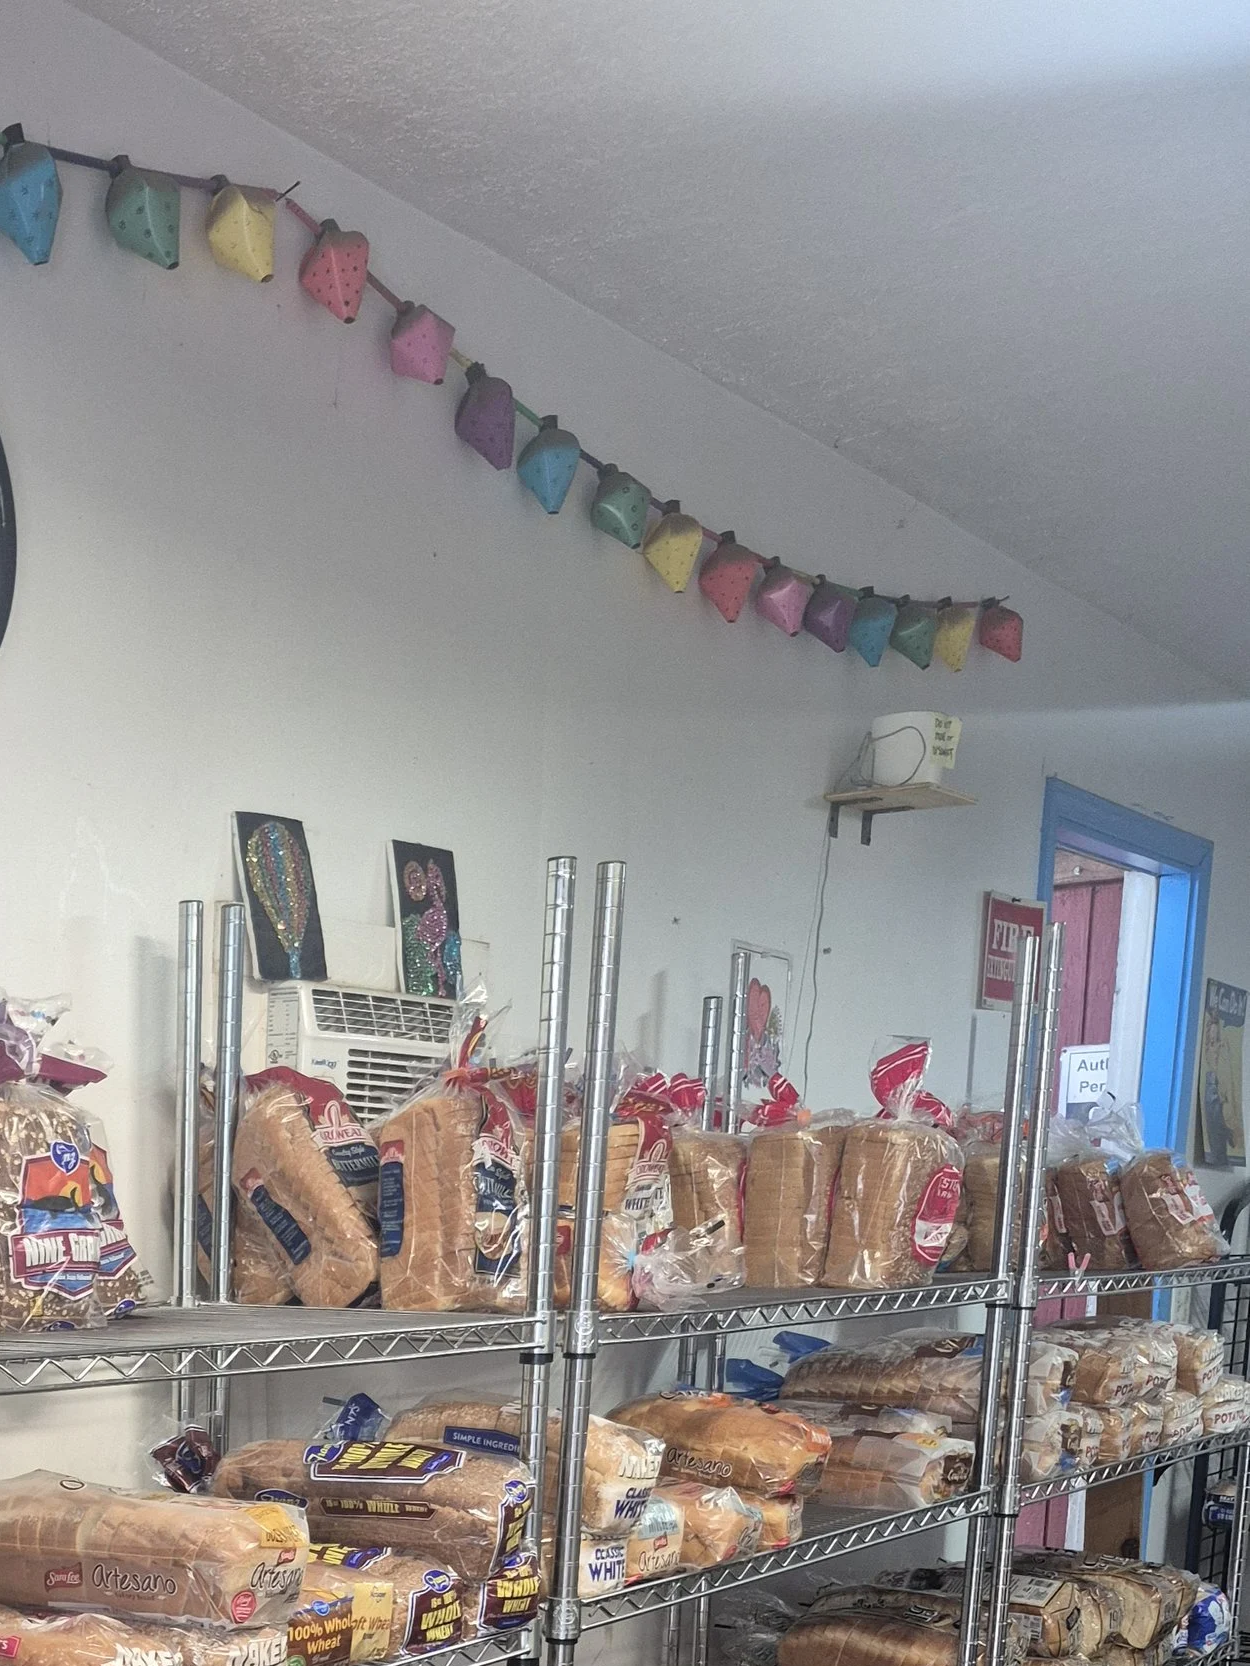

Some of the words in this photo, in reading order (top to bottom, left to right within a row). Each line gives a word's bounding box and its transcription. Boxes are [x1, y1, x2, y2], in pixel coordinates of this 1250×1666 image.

[452, 1432, 482, 1446] SIMPLE
[482, 1437, 520, 1453] INGREDI
[366, 1500, 401, 1514] WHOLE
[288, 1621, 323, 1642] 100%
[324, 1613, 352, 1634] Whol
[306, 1634, 342, 1655] Wheat
